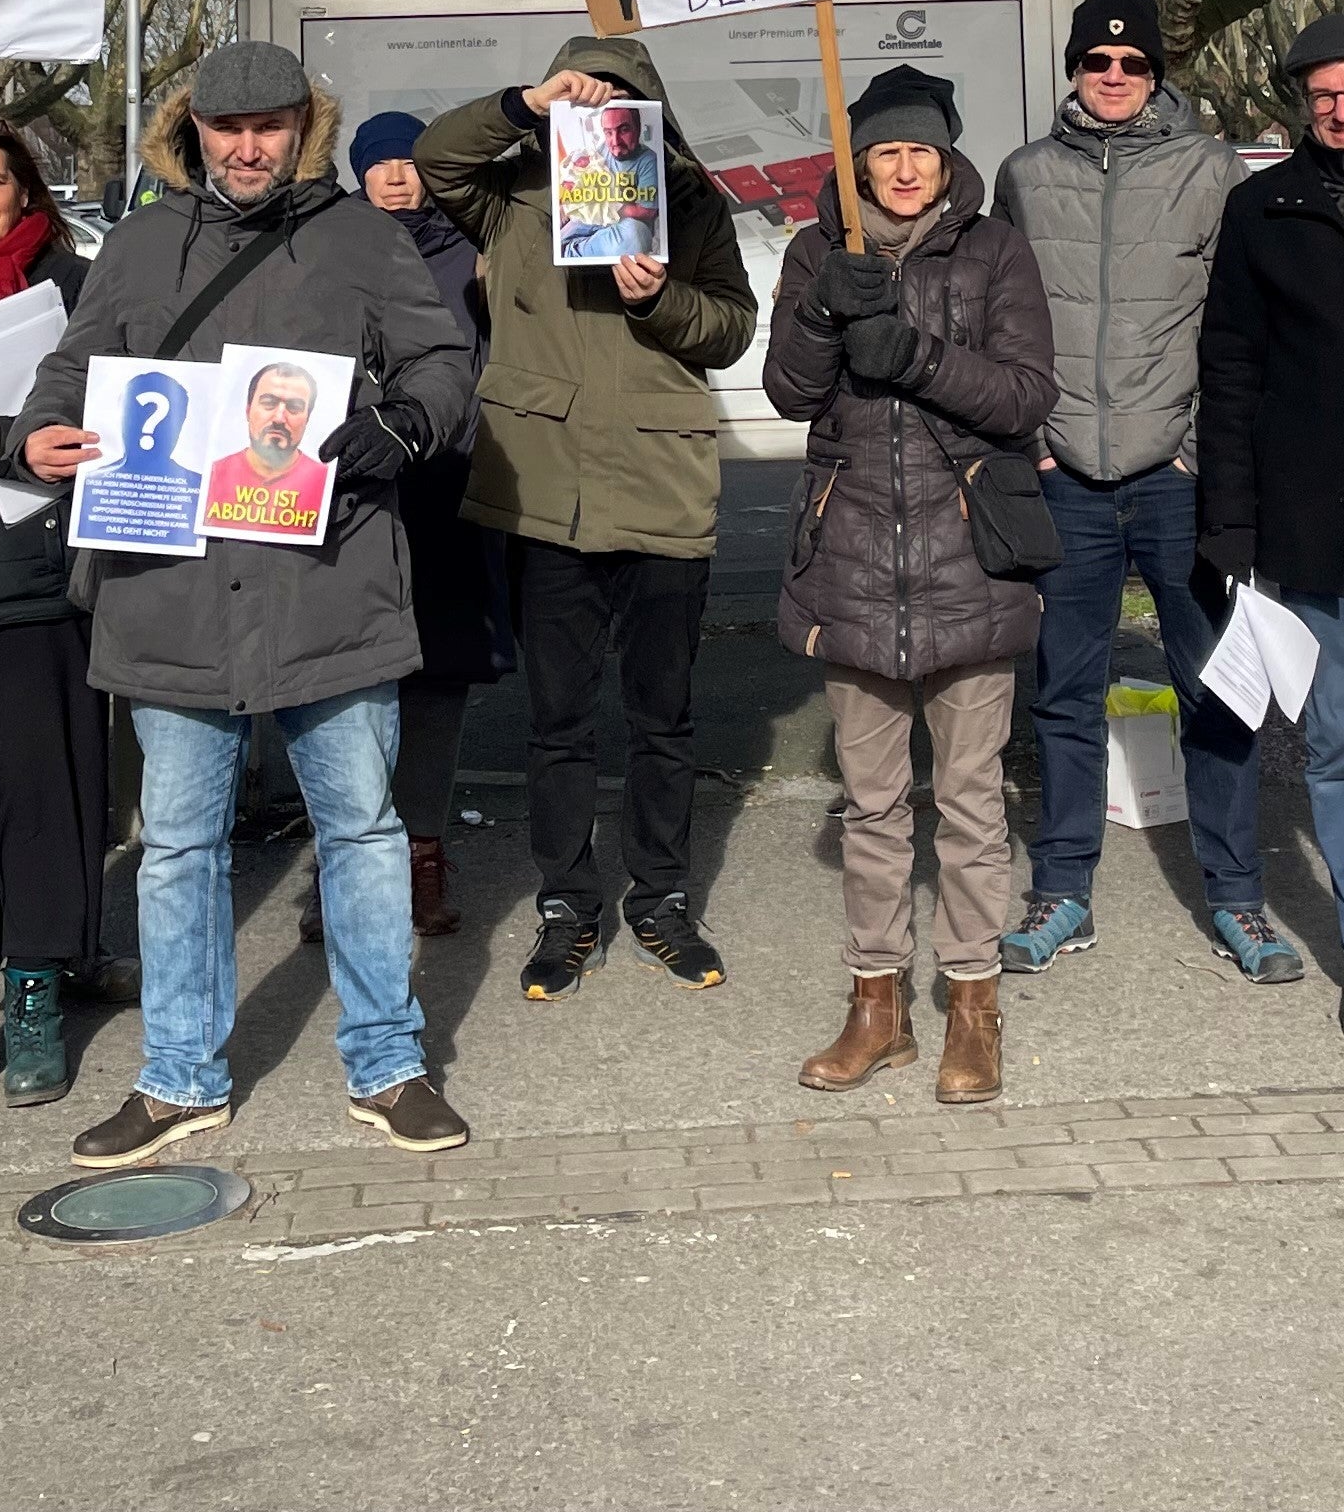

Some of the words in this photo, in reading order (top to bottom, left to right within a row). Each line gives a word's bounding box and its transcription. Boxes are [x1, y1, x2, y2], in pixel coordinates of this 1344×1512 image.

[728, 29, 758, 40] Unser
[759, 28, 806, 39] Premium
[386, 37, 499, 51] www.continentale.de
[878, 38, 943, 50] Continentale
[581, 171, 612, 187] WO
[615, 170, 636, 187] IST
[561, 186, 657, 203] ABDULLOH?
[235, 485, 270, 506] WO
[273, 489, 300, 509] IST
[207, 502, 318, 528] ABDULLOH?
